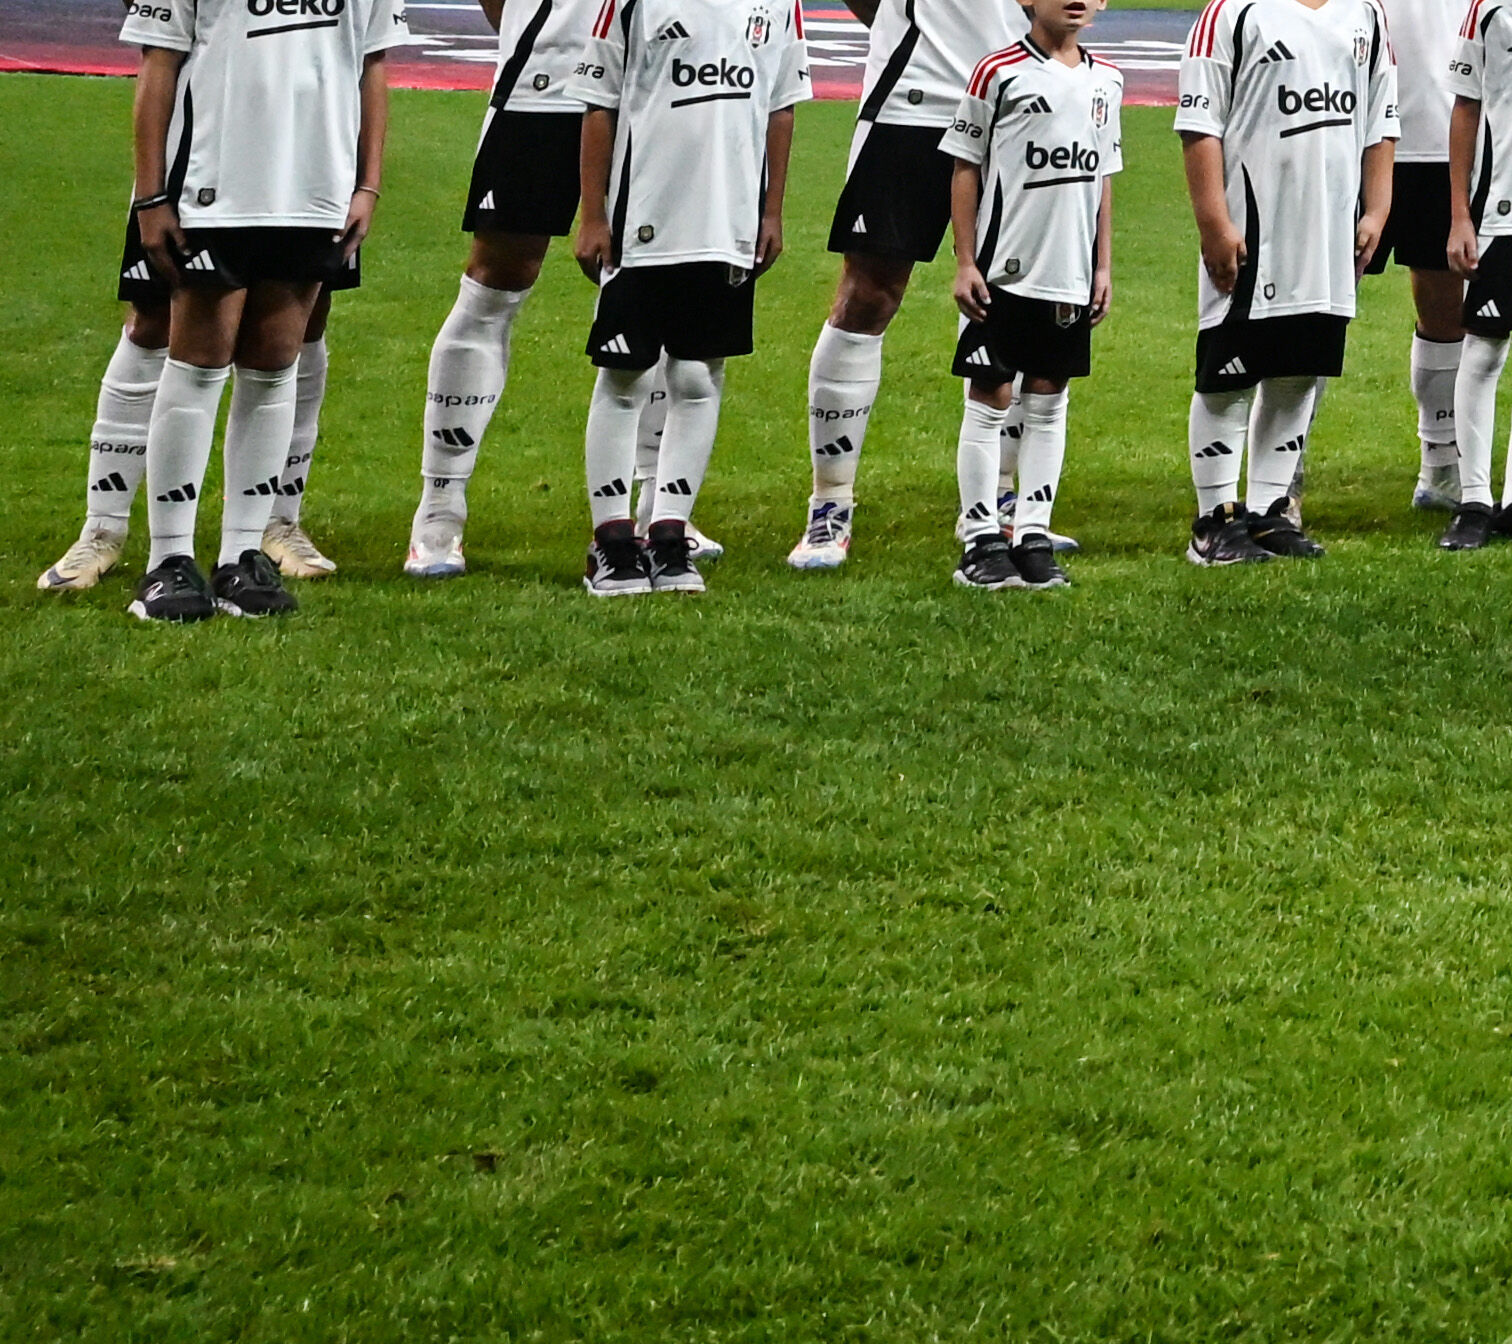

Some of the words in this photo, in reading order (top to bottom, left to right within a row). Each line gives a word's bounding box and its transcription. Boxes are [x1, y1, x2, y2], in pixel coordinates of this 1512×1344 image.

[671, 57, 755, 90] beko
[1278, 82, 1357, 116] beko
[1024, 140, 1100, 173] beko
